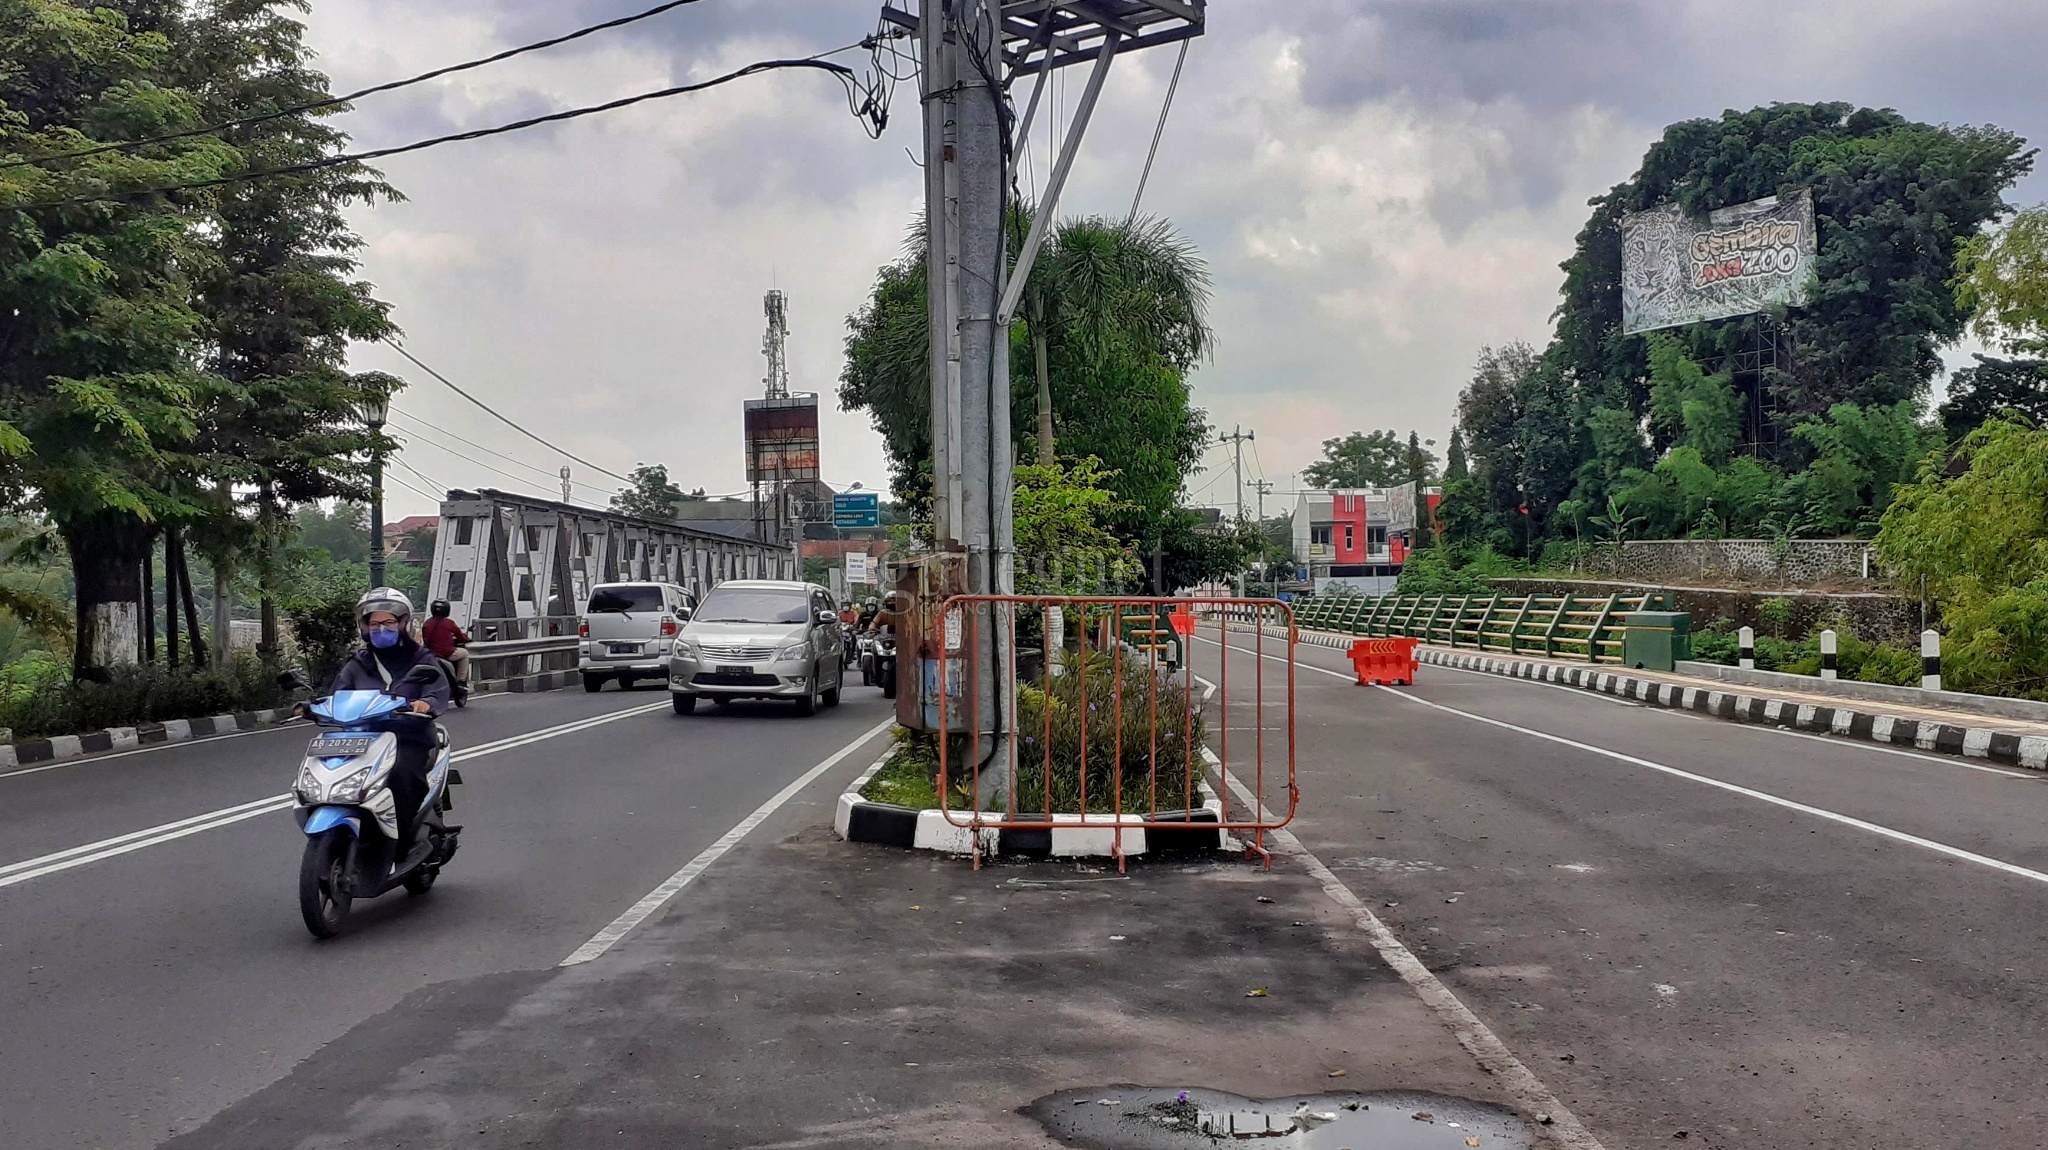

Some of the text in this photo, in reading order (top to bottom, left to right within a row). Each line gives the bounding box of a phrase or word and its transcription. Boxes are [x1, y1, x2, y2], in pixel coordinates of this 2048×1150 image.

[1692, 220, 1799, 261] Gembira
[1693, 247, 1798, 287] Loka ZOO
[312, 740, 325, 748] AB
[328, 739, 353, 747] 2072
